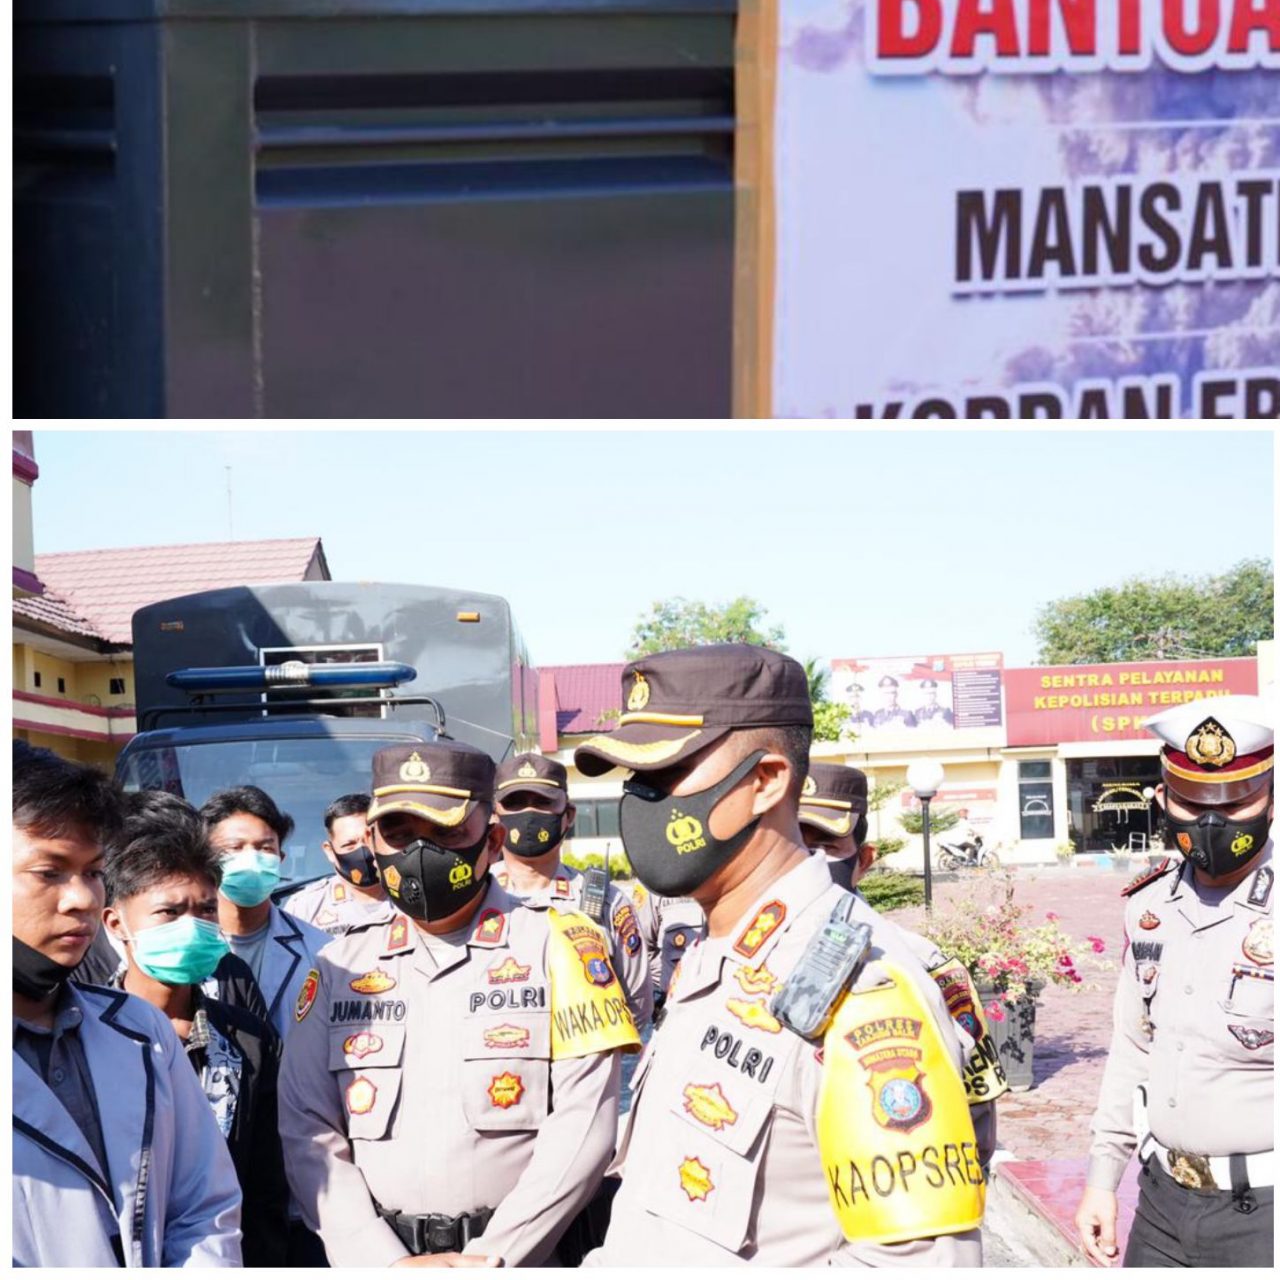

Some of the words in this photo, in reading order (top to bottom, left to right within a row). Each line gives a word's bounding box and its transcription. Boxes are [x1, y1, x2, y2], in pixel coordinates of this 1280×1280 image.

[1040, 673, 1113, 689] SENTRA
[1119, 669, 1224, 685] PELAYANAN
[1034, 692, 1143, 709] KEPOLISIAN
[676, 837, 706, 856] POLRI
[330, 998, 407, 1023] JUMANTO
[469, 986, 546, 1013] POLRI
[553, 1000, 605, 1042] WAKA
[700, 1024, 775, 1085] POLRI
